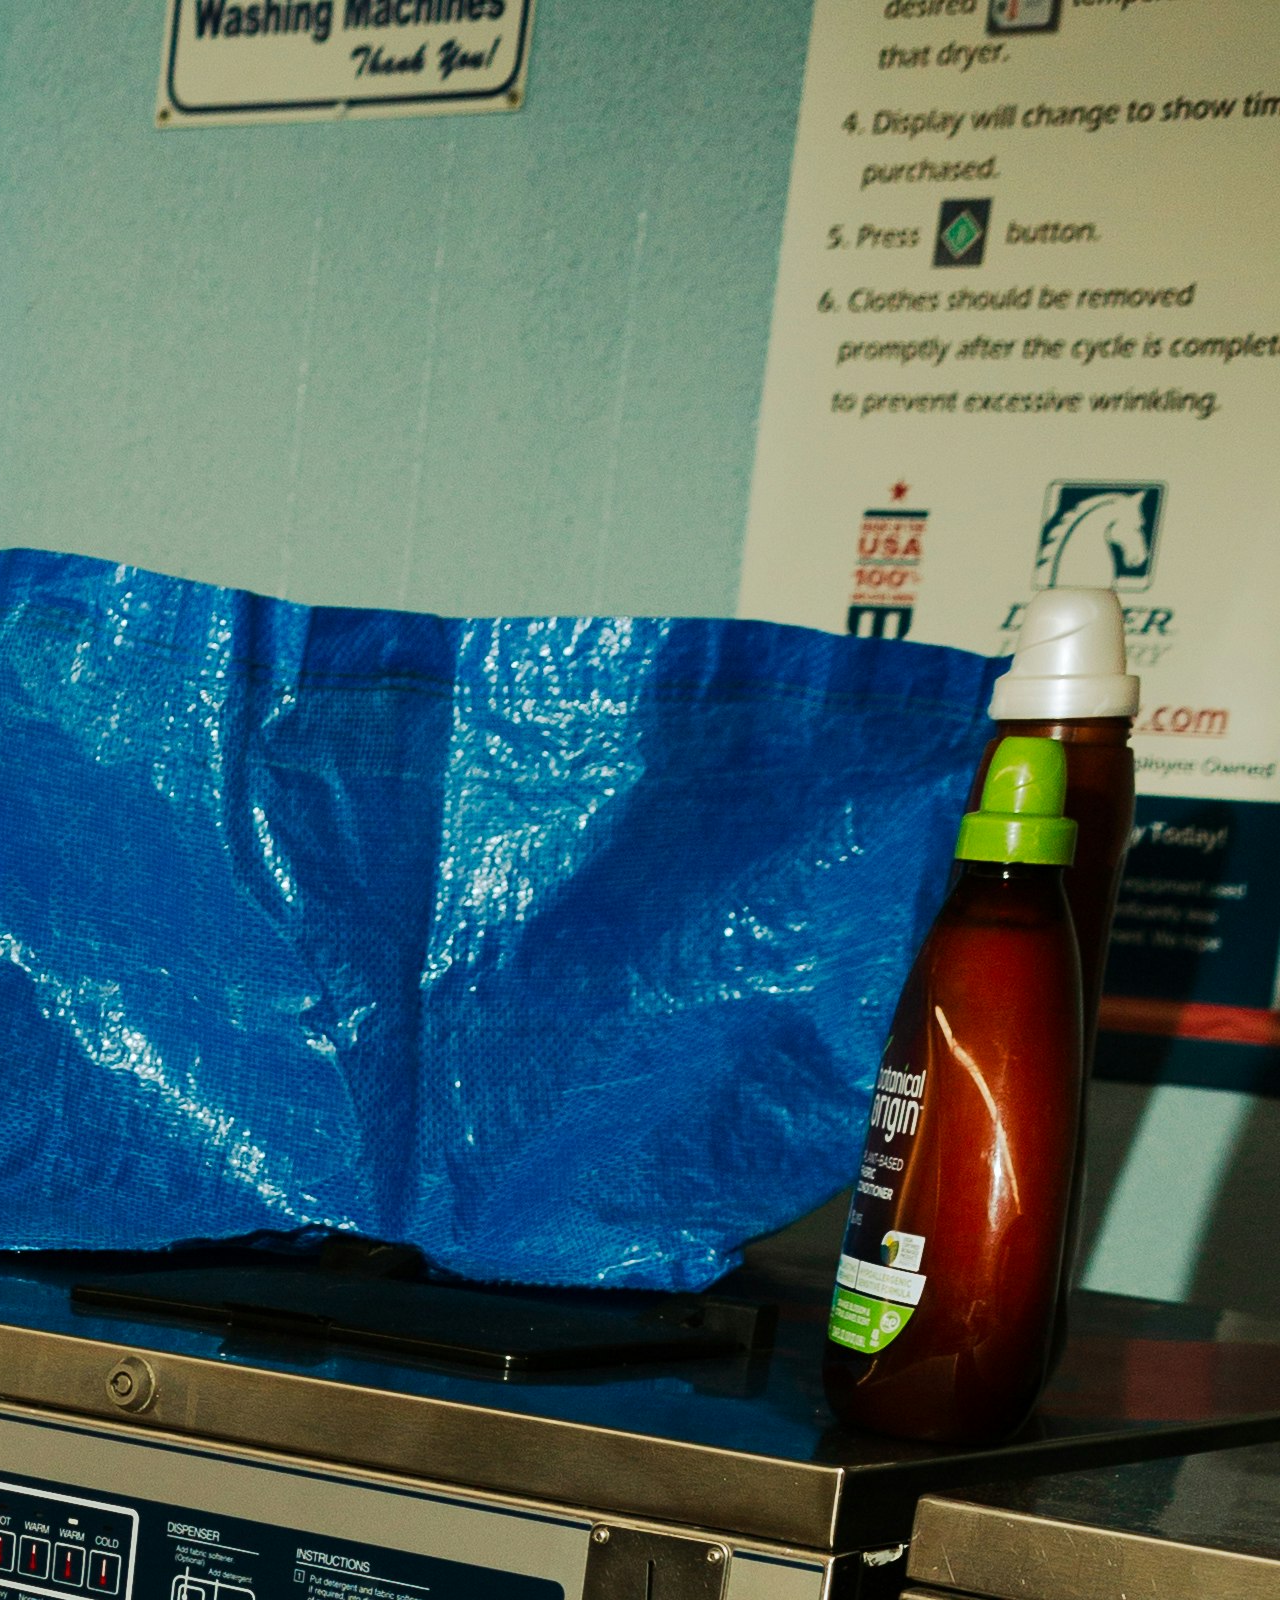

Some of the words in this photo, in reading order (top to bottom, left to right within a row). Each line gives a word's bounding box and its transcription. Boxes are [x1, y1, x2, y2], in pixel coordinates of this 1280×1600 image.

[194, 0, 333, 43] Washing
[343, 0, 506, 29] Machines
[349, 43, 428, 78] Thank
[438, 34, 502, 81] You!
[877, 43, 931, 71] that
[935, 42, 1010, 74] dryer.
[841, 111, 865, 136] 4.
[871, 107, 965, 140] Display
[970, 102, 1017, 130] will
[1020, 100, 1117, 134] change
[1125, 99, 1155, 124] to
[1159, 93, 1236, 123] show
[1241, 90, 1280, 119] tim
[860, 155, 1001, 192] purchased.
[827, 225, 850, 250] 5.
[855, 224, 921, 249] Press
[1004, 220, 1100, 246] button.
[817, 288, 840, 314] 6.
[847, 285, 940, 314] Clothes
[944, 284, 1034, 312] should
[1037, 283, 1067, 311] be
[1075, 281, 1197, 310] removed
[835, 335, 950, 366] promptly
[955, 334, 1017, 361] after
[1021, 333, 1067, 360] the
[1070, 333, 1135, 365] cycle
[1141, 333, 1162, 358] is
[1168, 331, 1280, 364] complet
[831, 391, 857, 415] to
[860, 390, 959, 418] prevent
[963, 389, 1082, 415] excessive
[1089, 388, 1220, 420] wrinkling.
[858, 537, 921, 556] USA
[871, 1093, 919, 1143] origin
[24, 1521, 50, 1534] WARM
[59, 1528, 85, 1541] WARM
[95, 1535, 119, 1549] COLD
[167, 1521, 220, 1542] DISPENSER
[296, 1548, 370, 1573] INSTRUCTIONS
[324, 1579, 358, 1592] detergent
